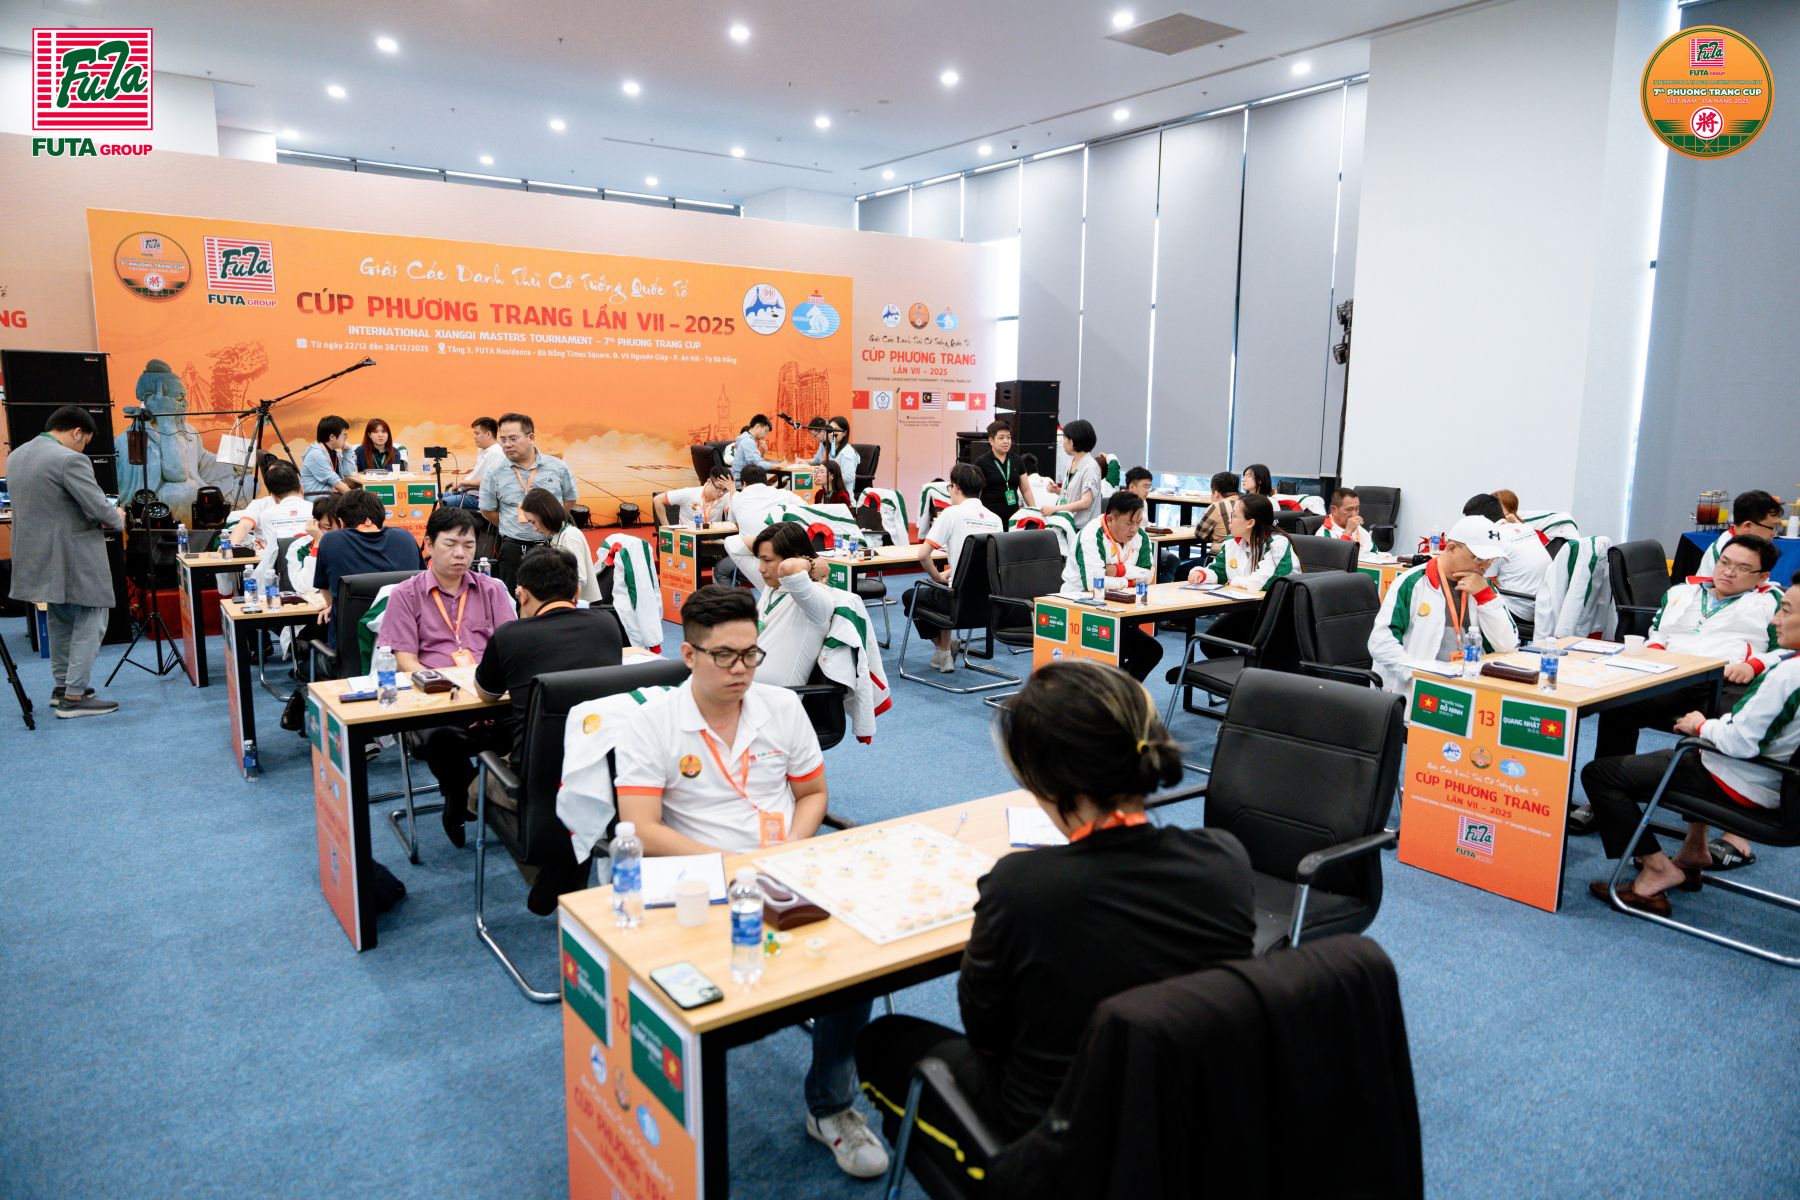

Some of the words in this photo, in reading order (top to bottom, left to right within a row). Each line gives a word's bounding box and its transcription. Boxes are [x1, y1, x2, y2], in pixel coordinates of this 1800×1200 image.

[407, 260, 448, 281] Các
[456, 264, 505, 285] Danh
[208, 293, 246, 306] FUTA
[247, 299, 277, 307] GROUP
[296, 288, 354, 316] CÚP
[367, 295, 478, 323] PHƯƠNG
[490, 303, 573, 328] TRANG
[636, 311, 665, 332] VII
[684, 314, 736, 336] 2025
[344, 341, 367, 351] 22/12
[348, 325, 431, 339] INTERNATIONAL
[435, 329, 476, 340] XIANGQI
[479, 332, 527, 342] MASTERS
[529, 334, 593, 345] TOURNAMENT
[617, 338, 652, 348] PHUONG
[655, 339, 683, 349] TRANG
[685, 340, 701, 350] CUP
[475, 346, 495, 354] FUTA
[861, 346, 885, 362] CÚP
[890, 349, 936, 364] PHƯƠNG
[940, 353, 976, 366] TRANG
[911, 367, 920, 375] VII
[930, 368, 948, 376] 2025
[1069, 622, 1080, 636] 10
[1478, 709, 1496, 728] 13
[1503, 716, 1523, 726] QUANG
[1415, 771, 1440, 786] CÚP
[1444, 778, 1498, 803] PHƯƠNG
[1503, 794, 1551, 817] TRANG
[1467, 800, 1479, 809] VII
[1490, 806, 1512, 819] 2025
[1456, 847, 1476, 859] FUTA
[614, 997, 629, 1034] 12
